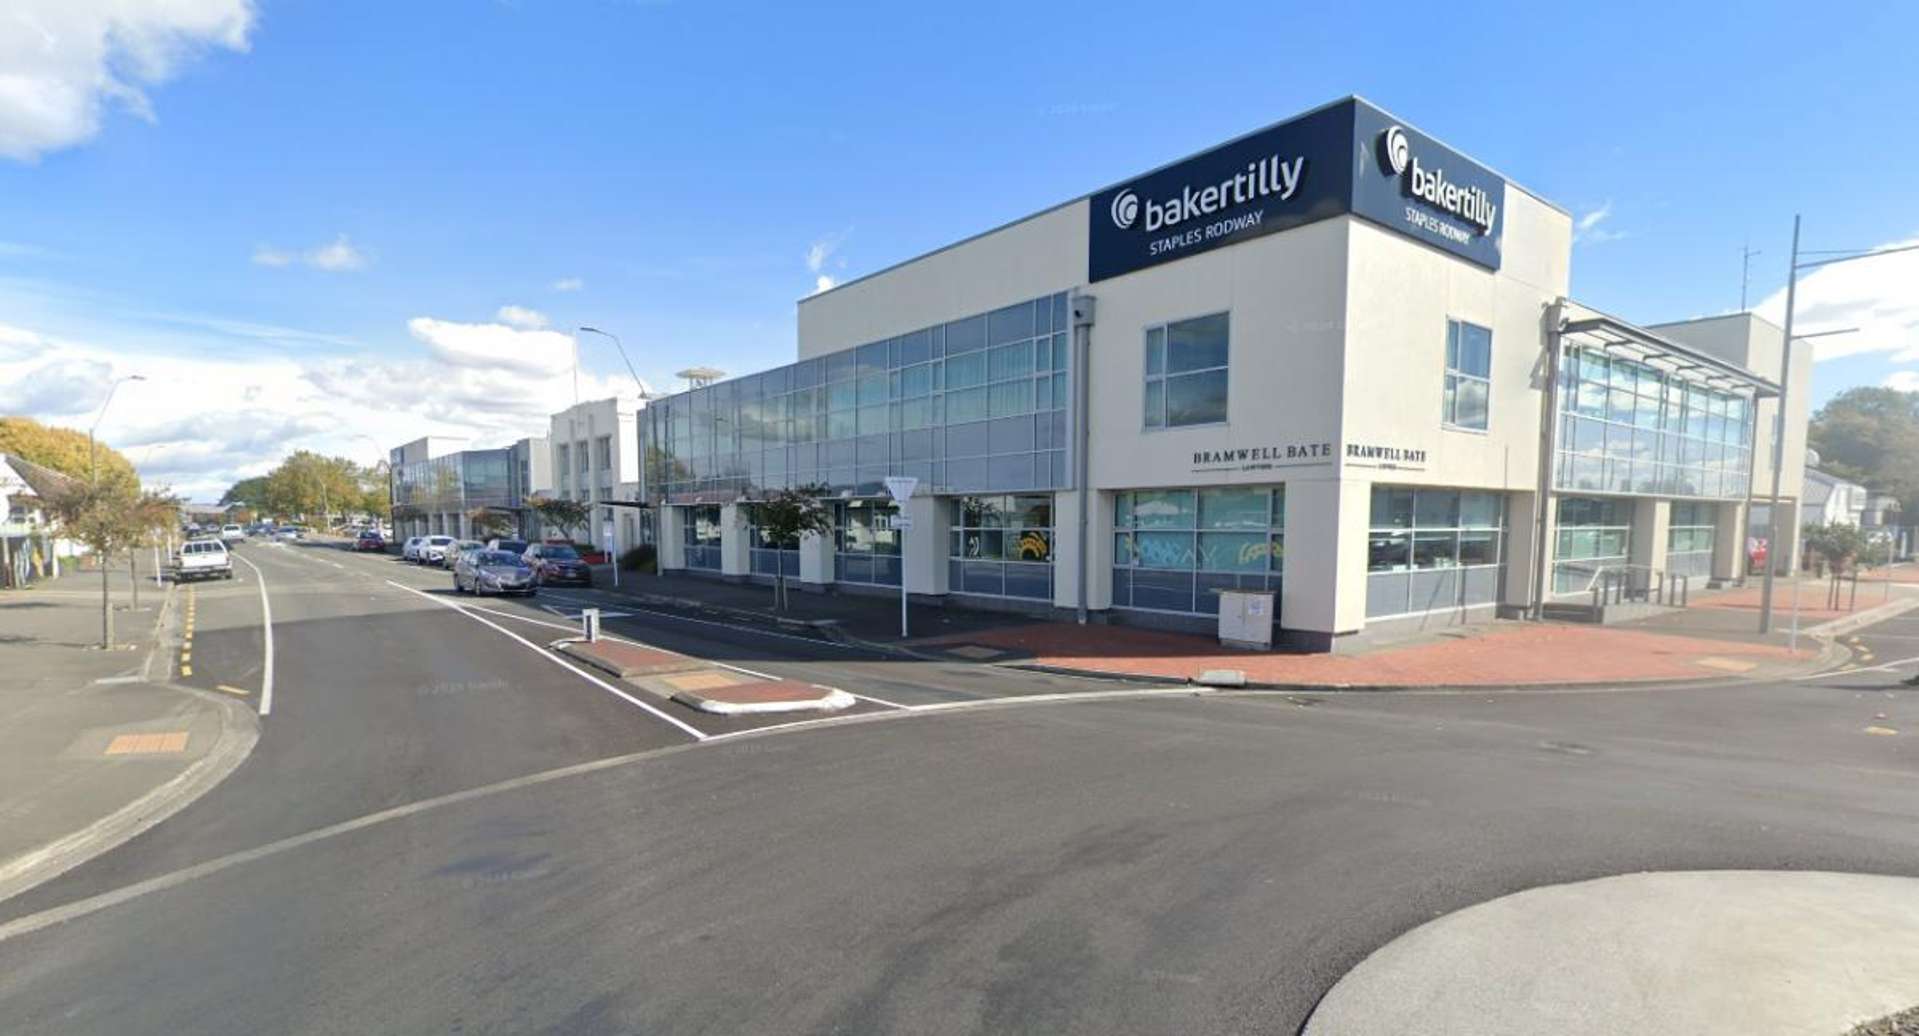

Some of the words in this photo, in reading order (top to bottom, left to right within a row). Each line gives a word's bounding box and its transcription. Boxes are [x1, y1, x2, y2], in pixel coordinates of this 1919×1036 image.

[1145, 154, 1304, 232] bakertilly
[1411, 156, 1496, 236] bakertilly
[1150, 230, 1202, 256] STAPLES
[1205, 209, 1264, 239] RODWAY
[1405, 207, 1440, 233] STAPLES
[1438, 222, 1472, 244] RODWAY
[1193, 446, 1281, 464] BRAMWELL
[1286, 443, 1333, 459] BATE
[1346, 444, 1401, 461] BRAMWELL
[1404, 450, 1427, 463] BATE
